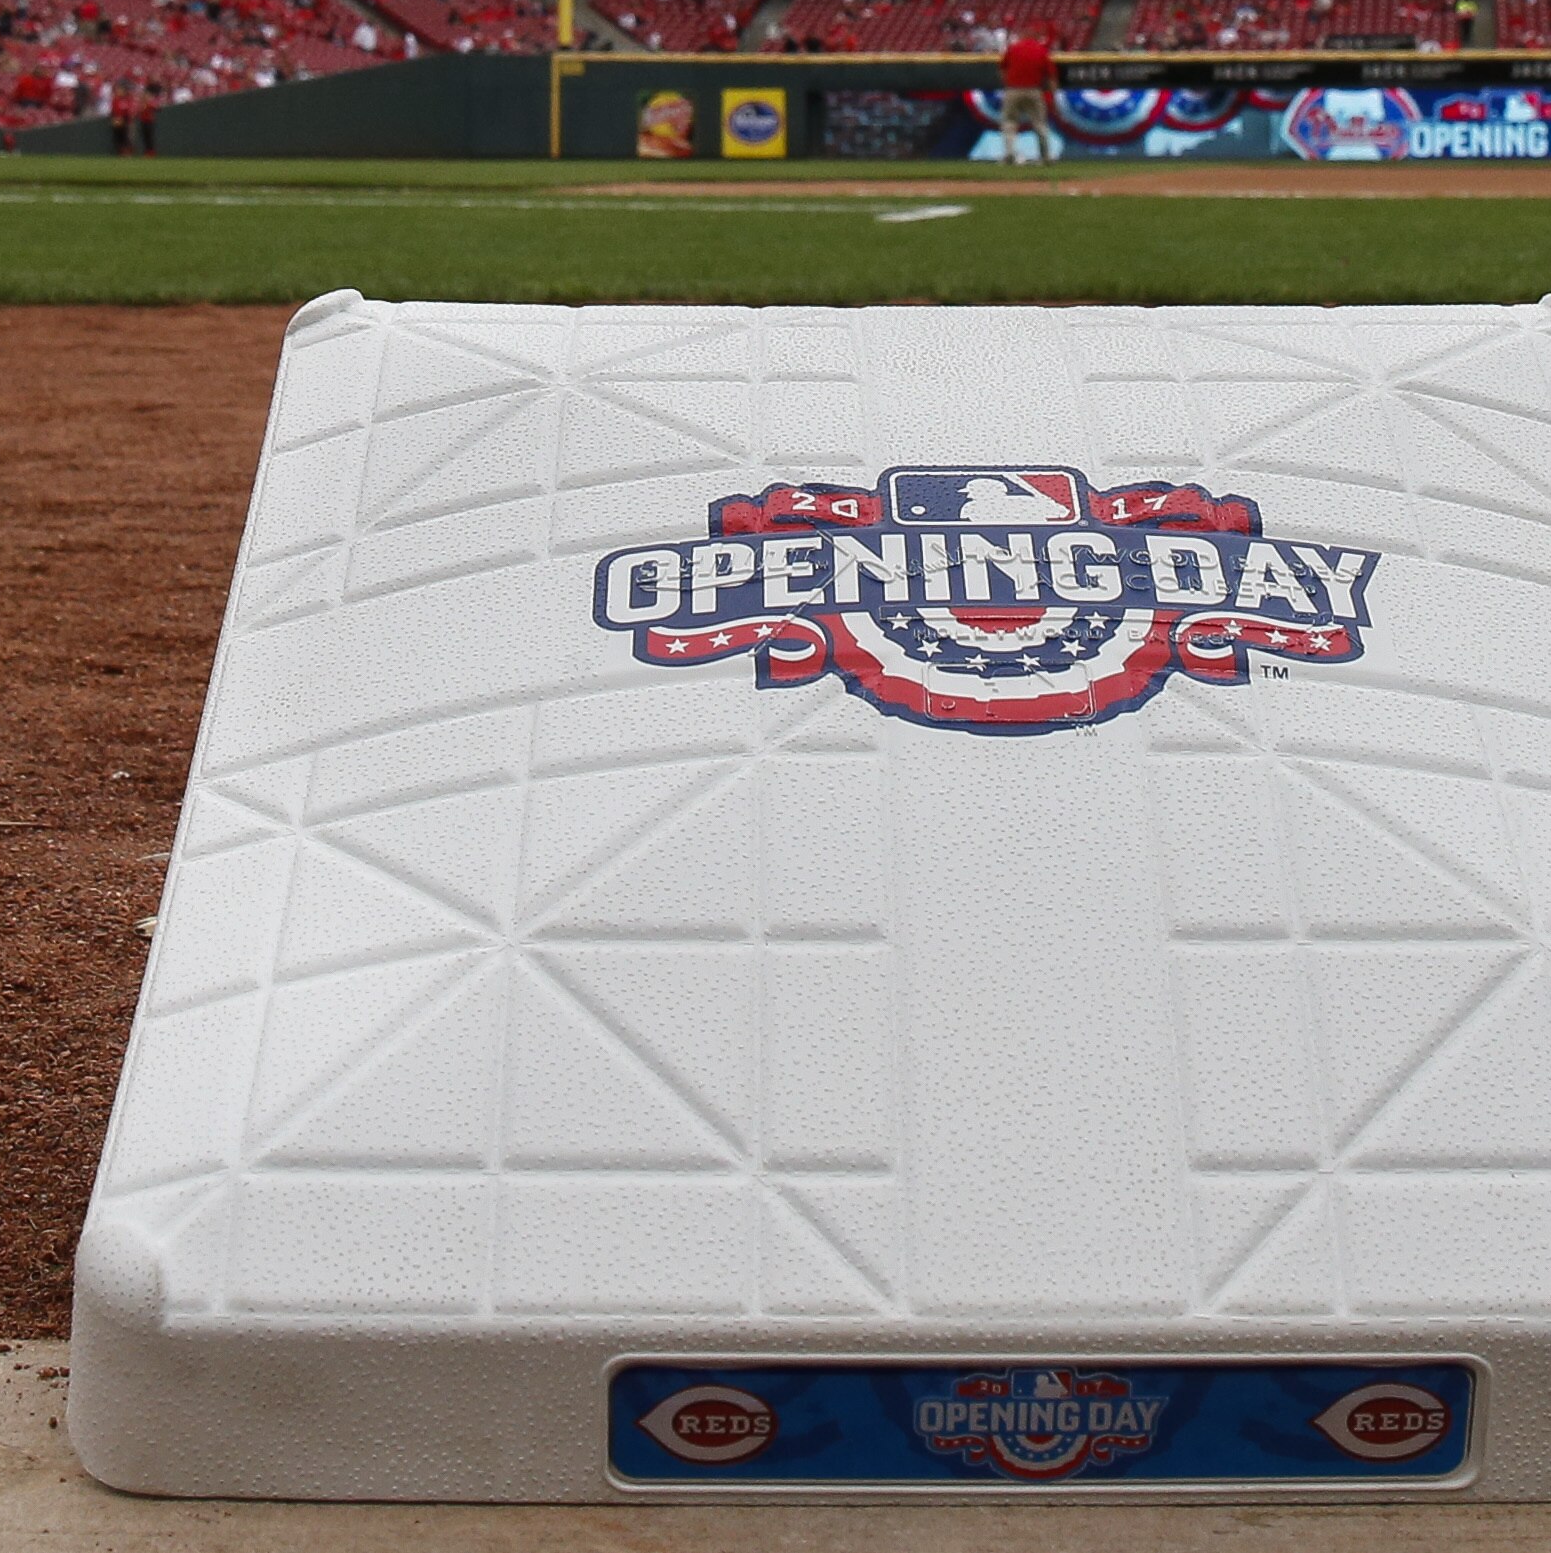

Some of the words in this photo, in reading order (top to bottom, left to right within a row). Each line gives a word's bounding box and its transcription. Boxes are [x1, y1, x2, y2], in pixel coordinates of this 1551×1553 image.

[1409, 121, 1549, 158] OPENING
[605, 531, 1123, 624] OPENING
[1144, 533, 1367, 619] DAY
[679, 1414, 772, 1435] REDS
[918, 1400, 1081, 1433] OPENING
[1087, 1400, 1161, 1432] DAY
[1353, 1412, 1445, 1432] REDS
